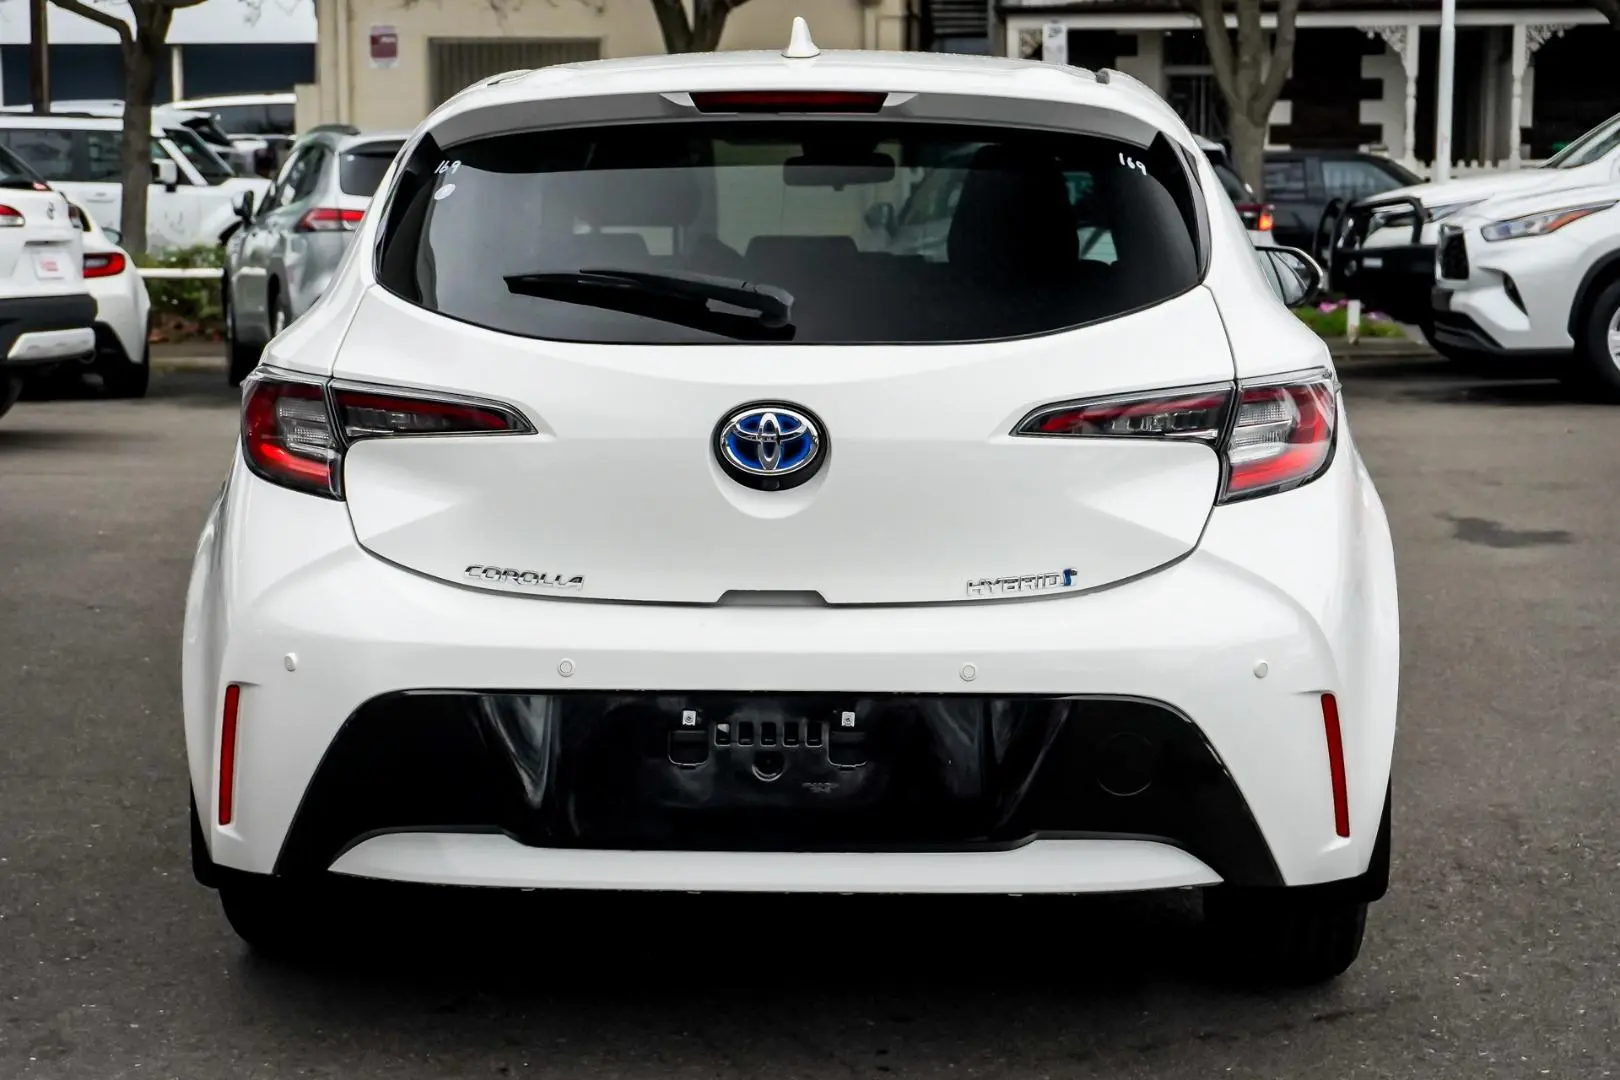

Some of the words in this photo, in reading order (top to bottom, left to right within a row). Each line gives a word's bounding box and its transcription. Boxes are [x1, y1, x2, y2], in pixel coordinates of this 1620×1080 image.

[433, 159, 462, 175] 169
[464, 565, 585, 590] COROLLA
[967, 572, 1061, 595] HYBRID
